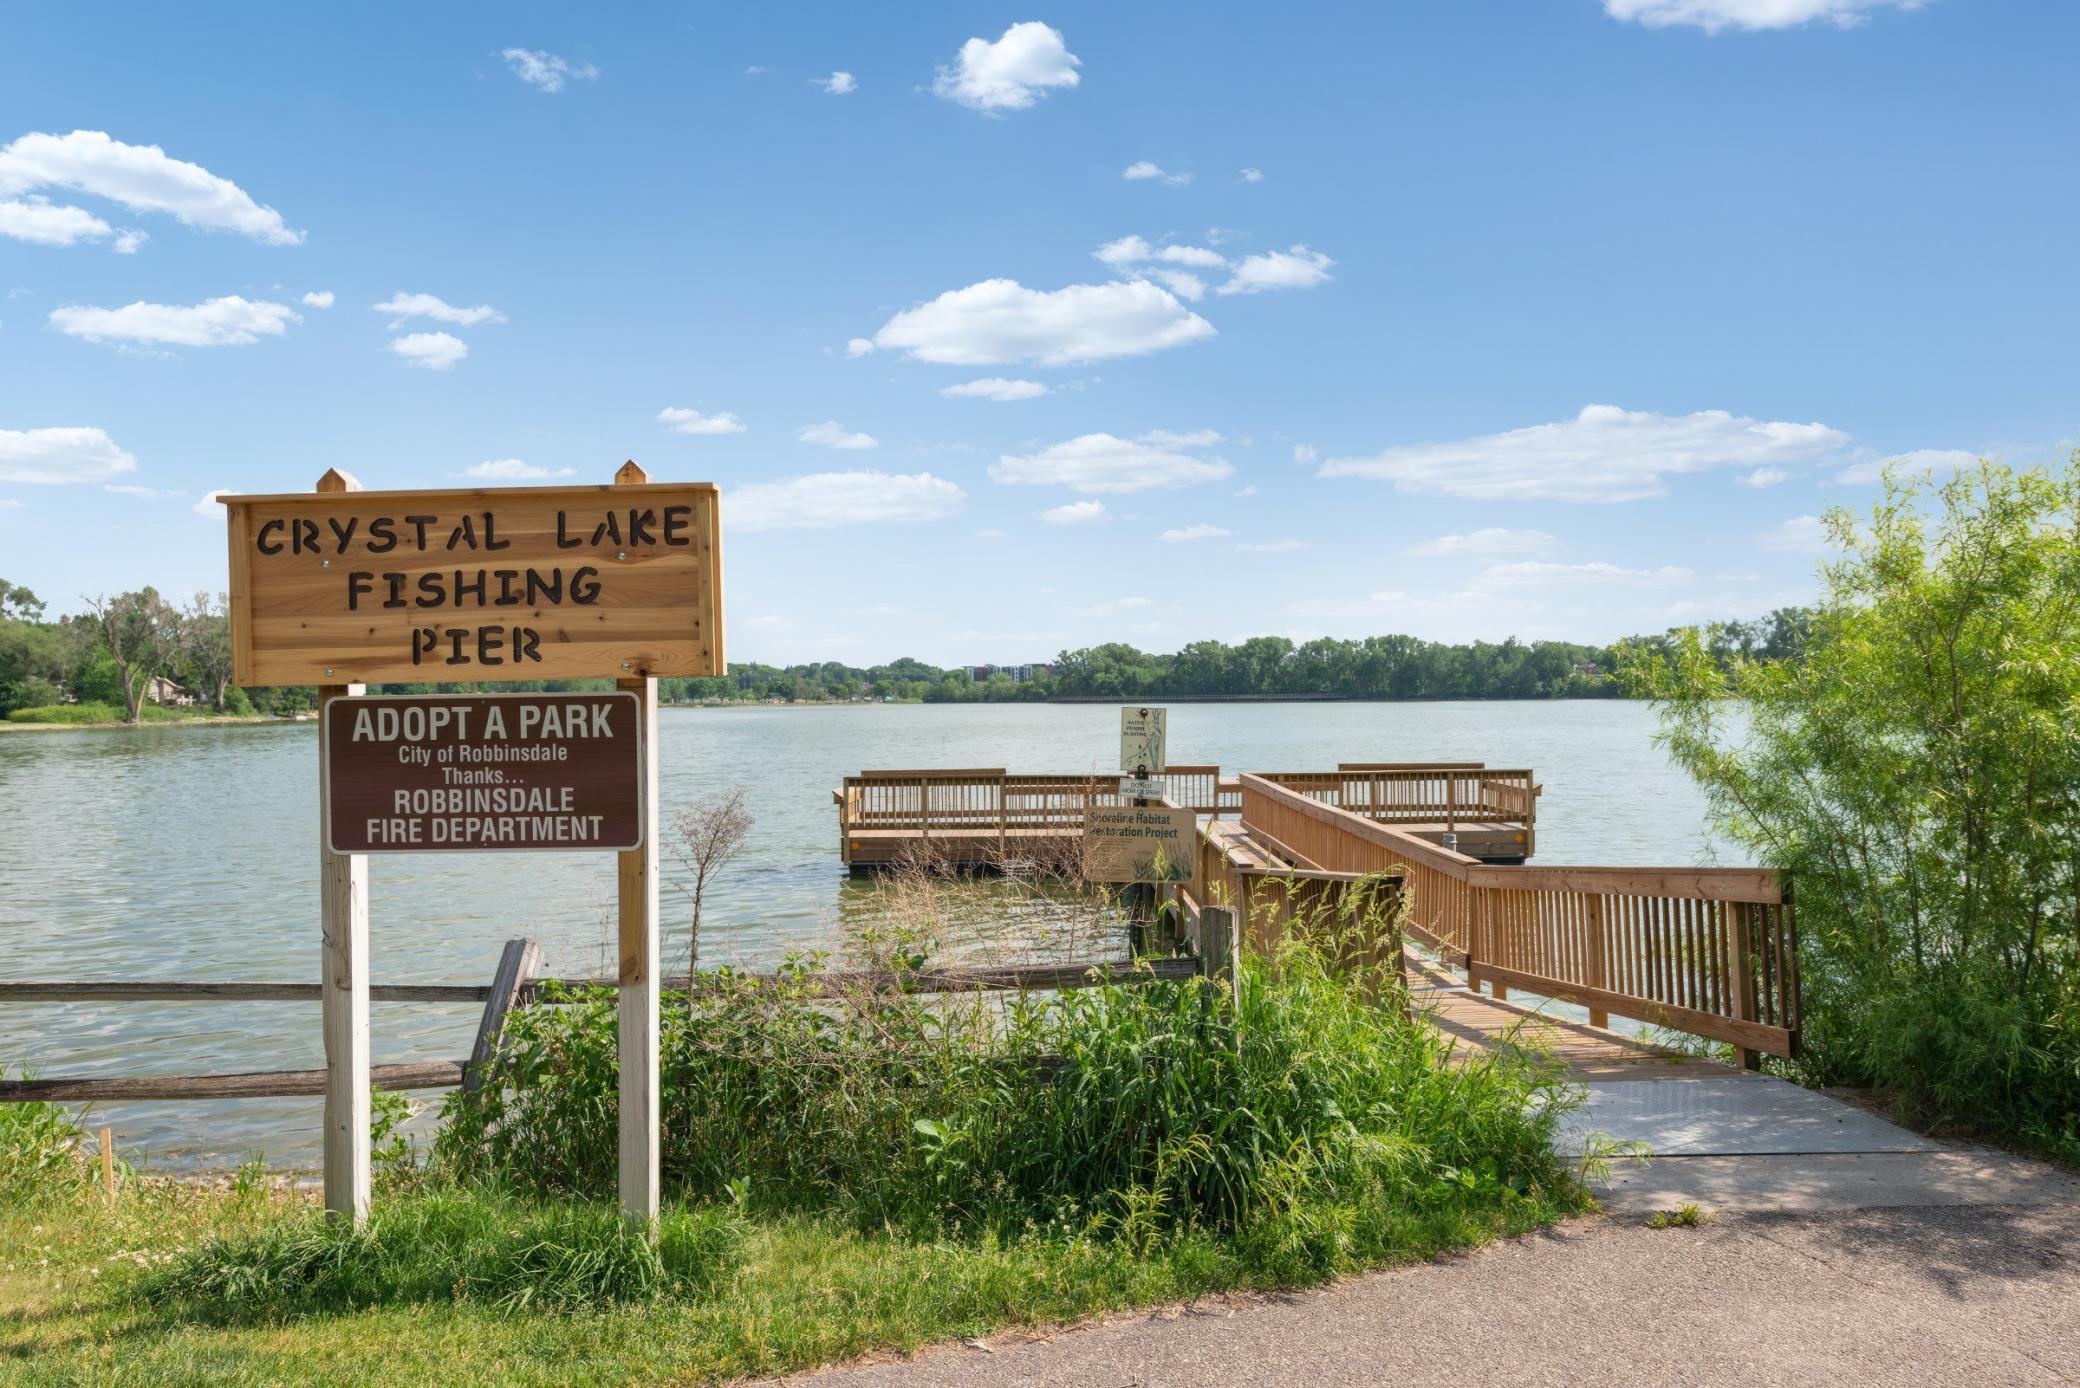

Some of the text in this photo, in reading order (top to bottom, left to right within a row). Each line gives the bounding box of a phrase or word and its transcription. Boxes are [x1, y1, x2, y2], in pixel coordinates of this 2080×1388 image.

[257, 505, 692, 556] CRYSTAL LAKE
[348, 566, 602, 611] FISHING
[412, 626, 542, 666] PIER
[352, 703, 614, 742] ADOPT A PARK
[398, 743, 568, 767] City of Robbinsdale
[442, 766, 525, 785] Thanks...
[394, 787, 575, 814] ROBBINSDALE
[367, 815, 603, 843] FIRE DEPARTMENT
[1145, 827, 1178, 839] Project
